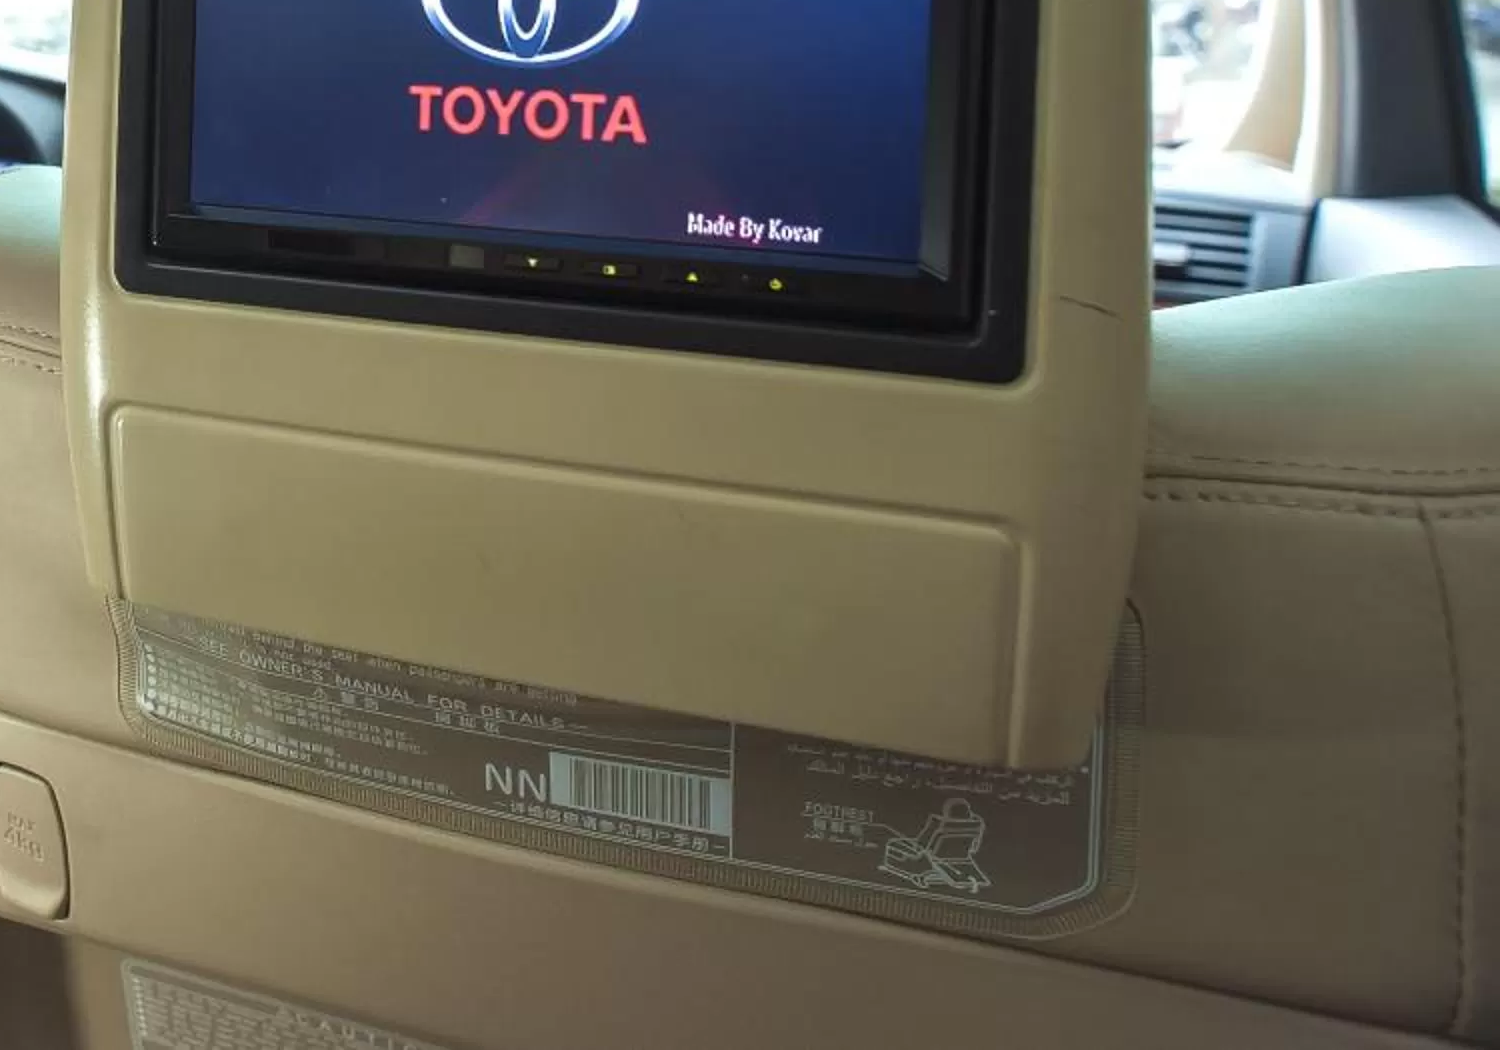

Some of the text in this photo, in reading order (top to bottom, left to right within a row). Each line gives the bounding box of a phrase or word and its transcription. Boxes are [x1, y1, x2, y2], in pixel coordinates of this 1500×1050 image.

[409, 84, 648, 145] TOYOTA
[687, 211, 736, 238] Made
[739, 216, 765, 245] By
[239, 648, 325, 683] OWNER'S
[335, 673, 416, 704] MANUAL
[427, 693, 469, 714] FOR
[480, 704, 566, 731] DETAILS
[484, 762, 547, 803] NN
